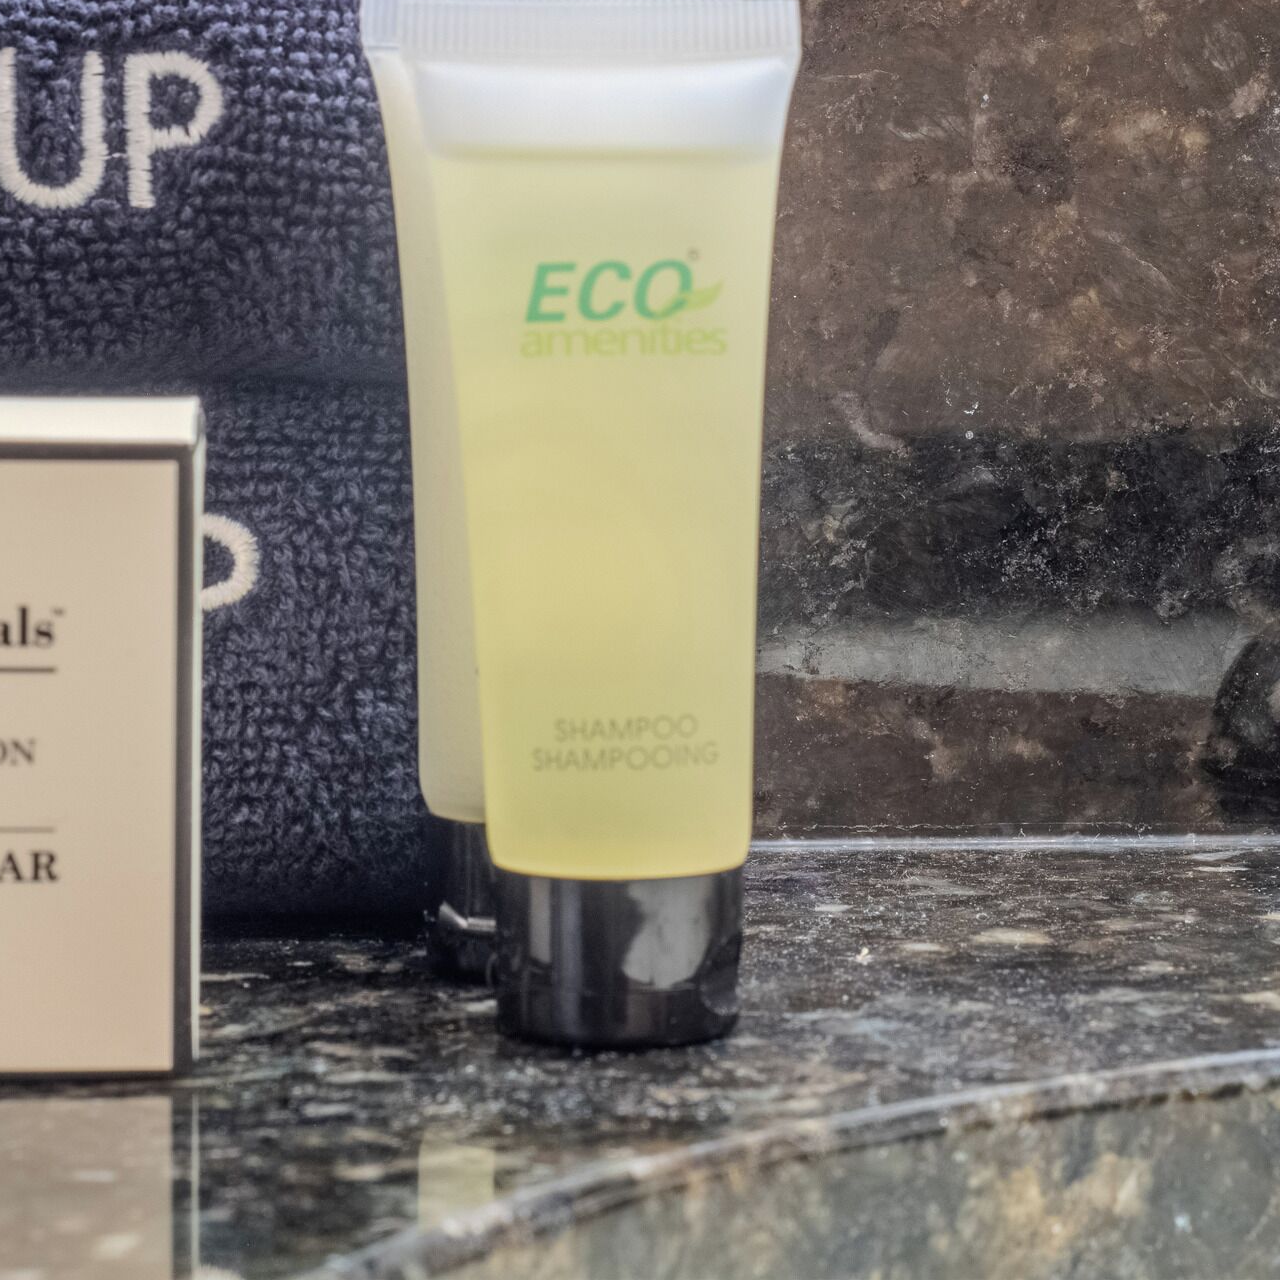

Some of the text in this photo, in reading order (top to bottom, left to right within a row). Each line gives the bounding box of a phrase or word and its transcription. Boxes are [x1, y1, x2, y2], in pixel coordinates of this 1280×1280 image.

[524, 259, 694, 325] ECO
[520, 324, 728, 359] amenities
[554, 713, 699, 743] SHAMPOO
[532, 740, 721, 771] SHAMPOOING
